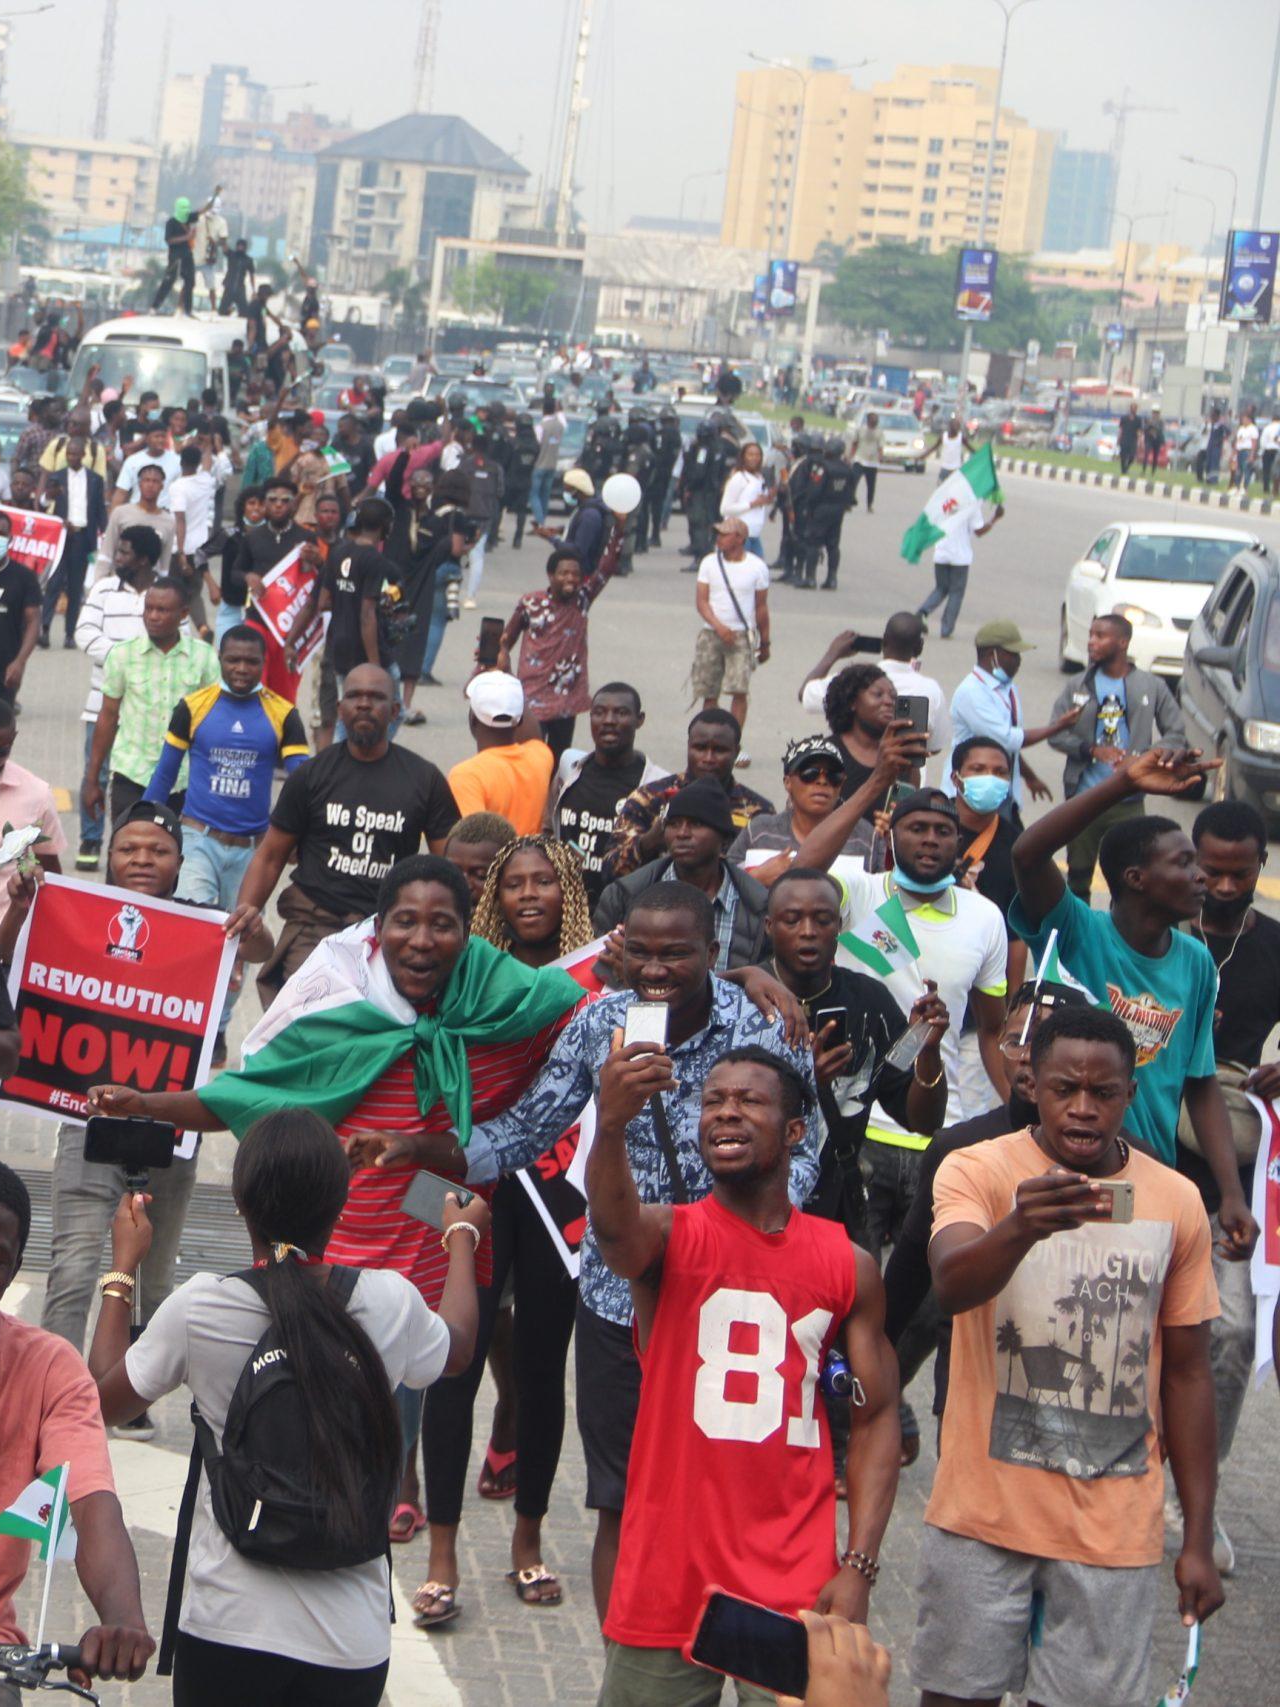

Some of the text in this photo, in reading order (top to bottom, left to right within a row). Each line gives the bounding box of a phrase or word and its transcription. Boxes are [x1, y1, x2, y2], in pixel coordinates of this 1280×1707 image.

[8, 535, 56, 561] HARI
[209, 775, 251, 798] TINA
[326, 802, 406, 834] We Speak
[561, 807, 577, 826] We
[352, 832, 375, 854] Of
[579, 832, 598, 852] Of
[28, 961, 204, 1025] REVOLUTION
[19, 1006, 192, 1092] NOW!
[535, 1128, 581, 1181] SA
[693, 1287, 834, 1449] 81
